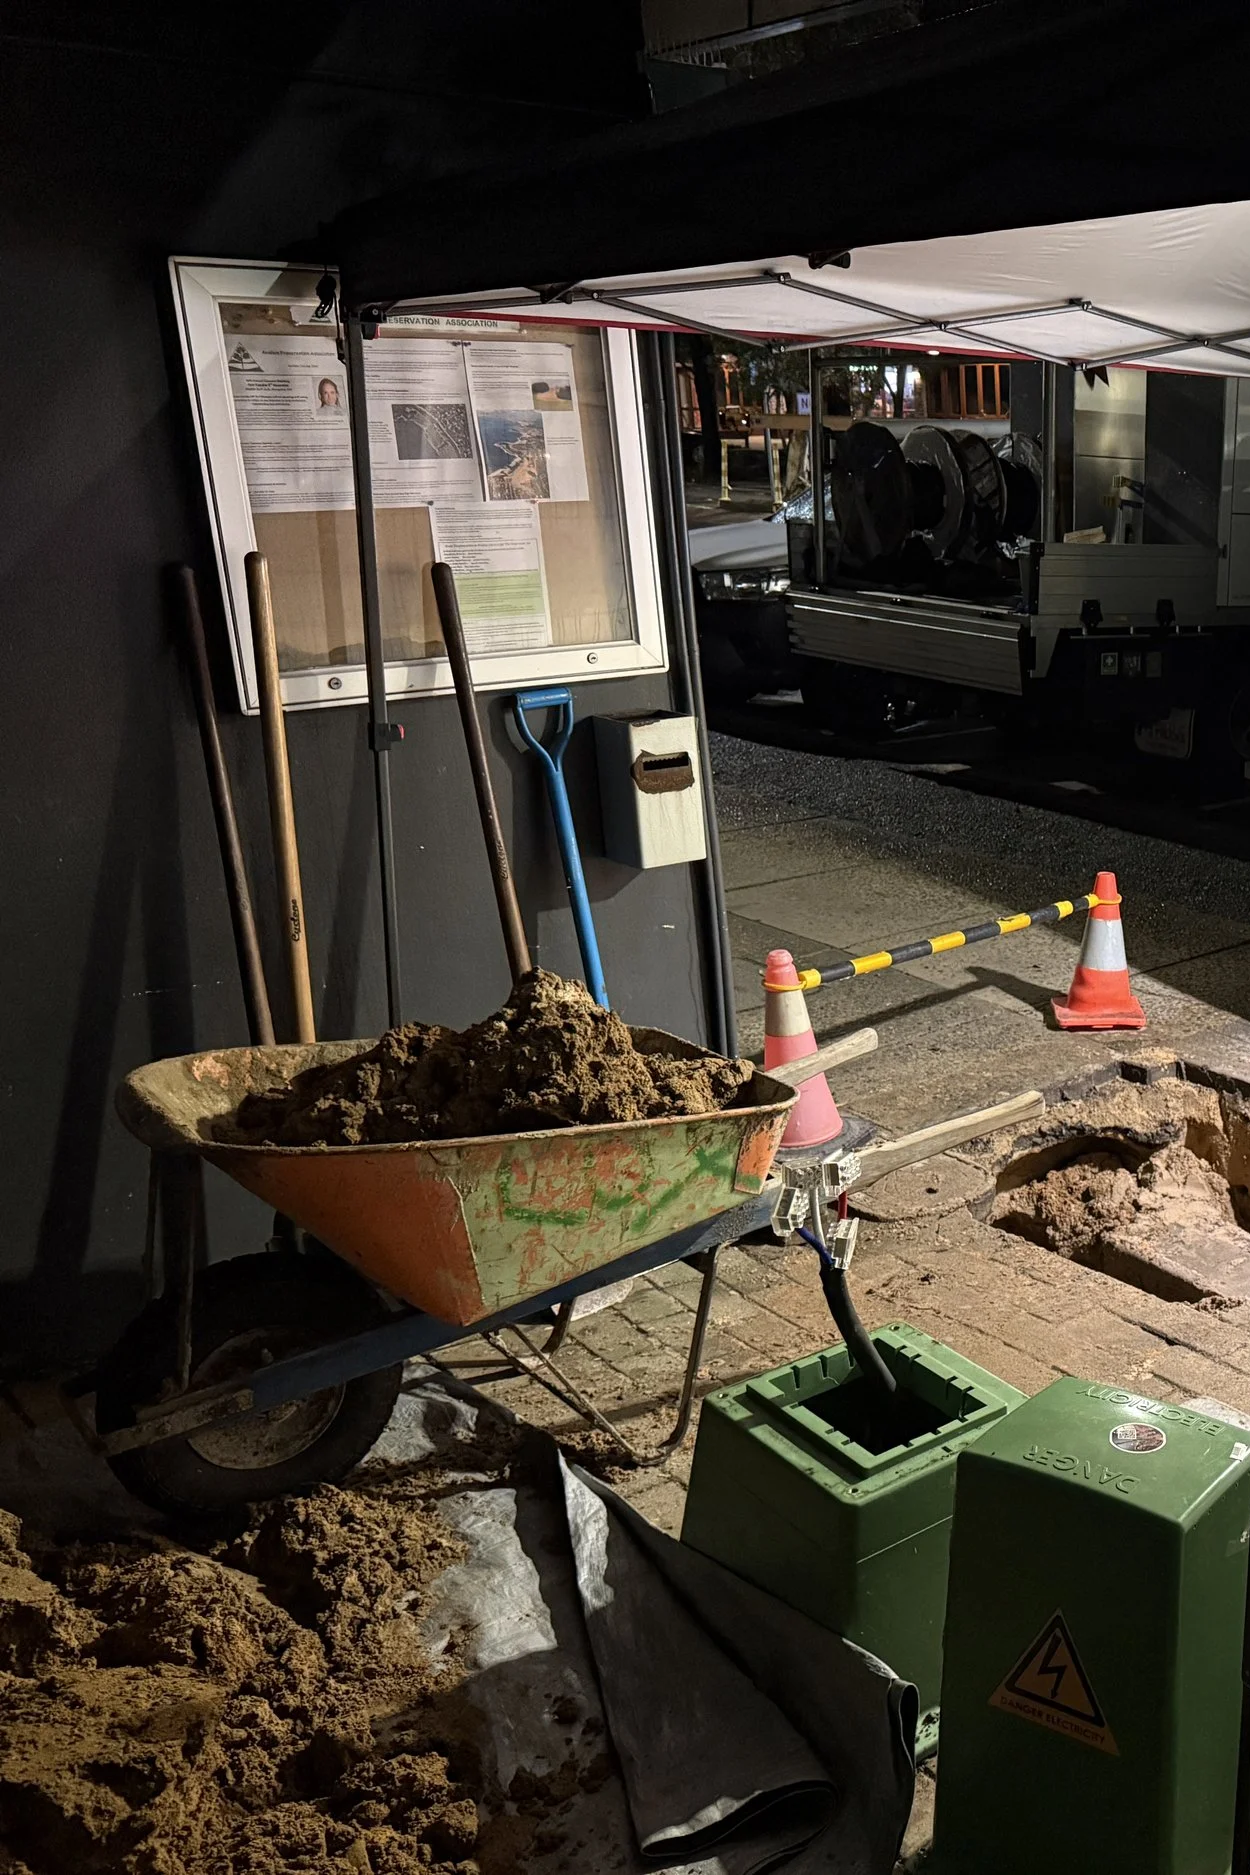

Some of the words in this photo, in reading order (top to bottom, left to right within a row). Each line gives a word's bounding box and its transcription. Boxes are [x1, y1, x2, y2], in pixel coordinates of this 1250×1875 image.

[387, 316, 441, 326] ESERVATION
[445, 319, 499, 328] ASSOCIATION
[1075, 1384, 1226, 1437] ELECTRICITY
[1023, 1445, 1141, 1495] DANGER
[1000, 1696, 1043, 1721] DANGER
[1046, 1713, 1106, 1744] ELECTRICITY
